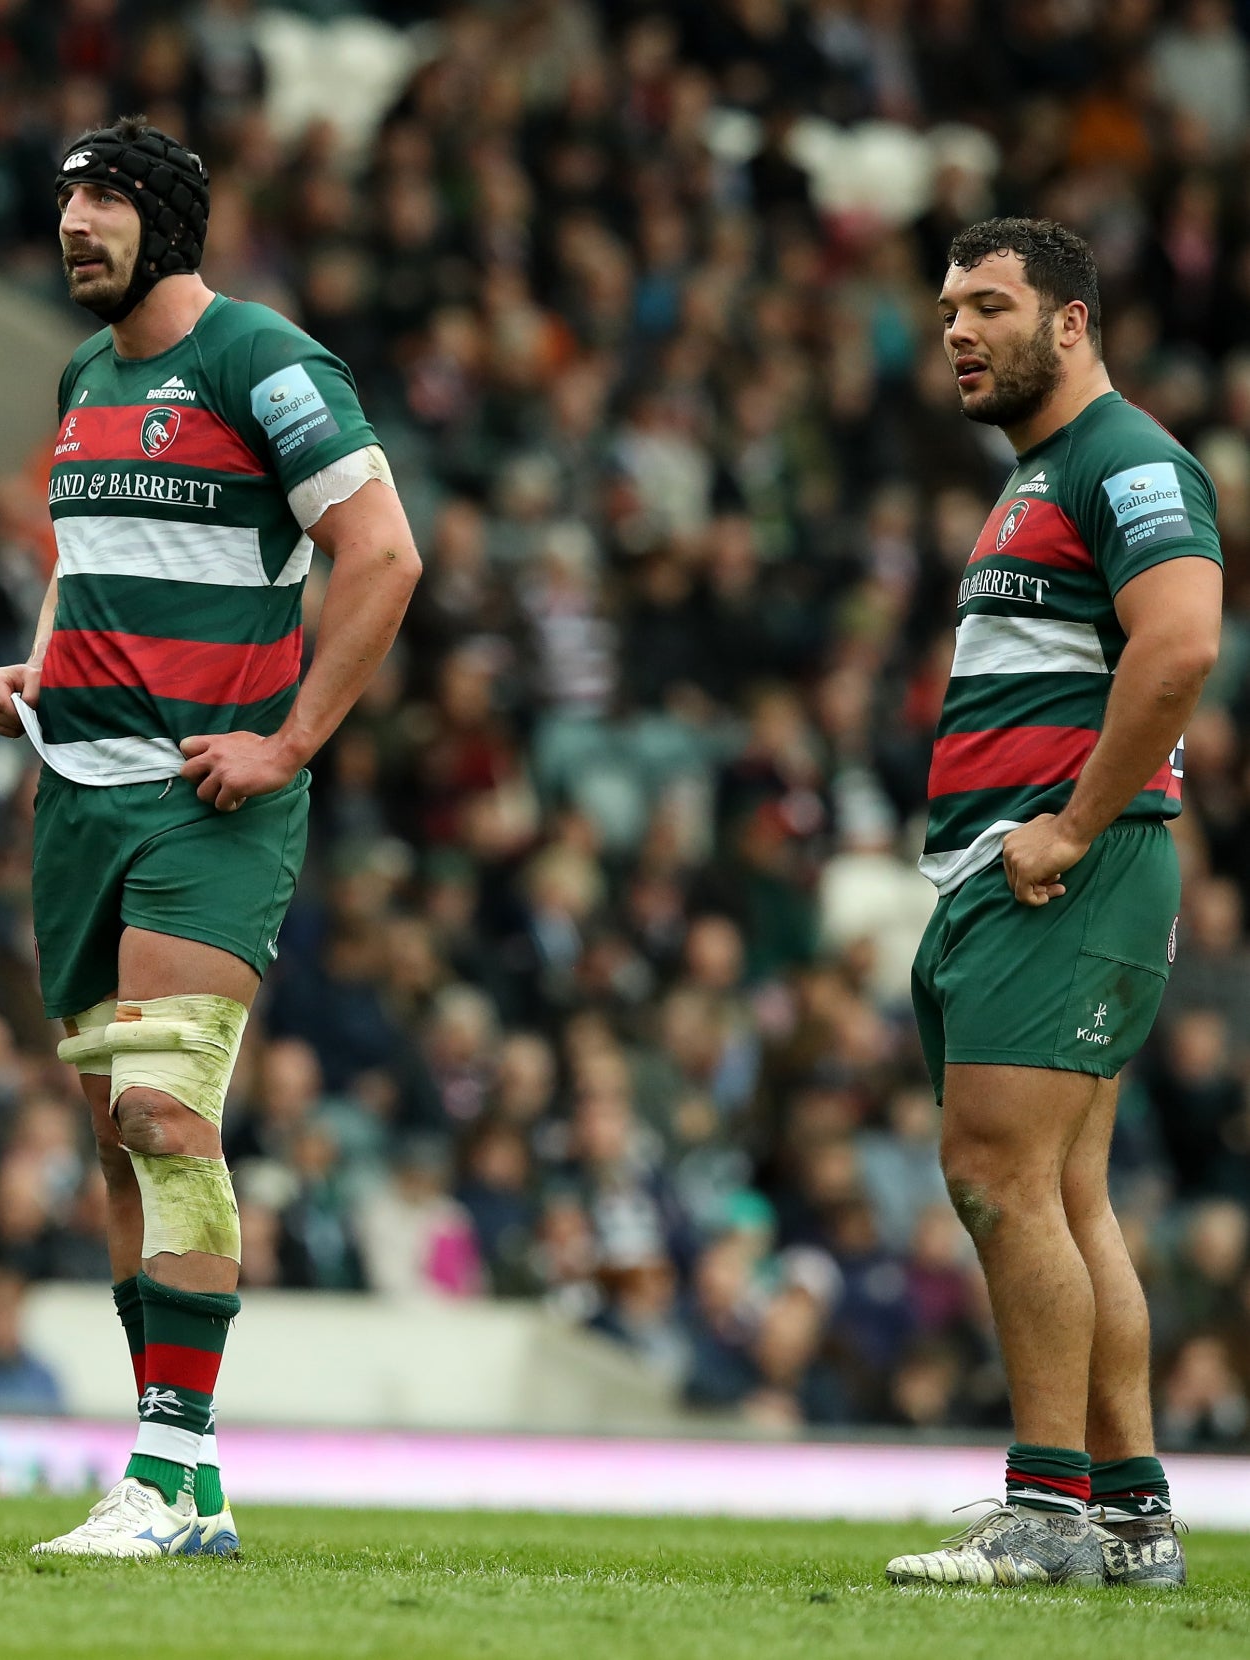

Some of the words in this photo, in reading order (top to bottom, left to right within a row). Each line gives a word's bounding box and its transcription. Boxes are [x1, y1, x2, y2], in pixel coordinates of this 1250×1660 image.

[146, 389, 196, 401] BREEDON
[263, 391, 316, 426] Gallagher
[276, 414, 328, 449] PREMIERSHIP
[279, 434, 306, 457] RUGBY
[48, 474, 85, 501] LAND
[88, 473, 106, 500] &
[108, 473, 222, 509] BARRETT
[1117, 490, 1178, 514] Gallagher
[1124, 514, 1184, 539] PREMIERSHIP
[1126, 527, 1157, 547] RUGBY
[1076, 1027, 1112, 1046] KUKR
